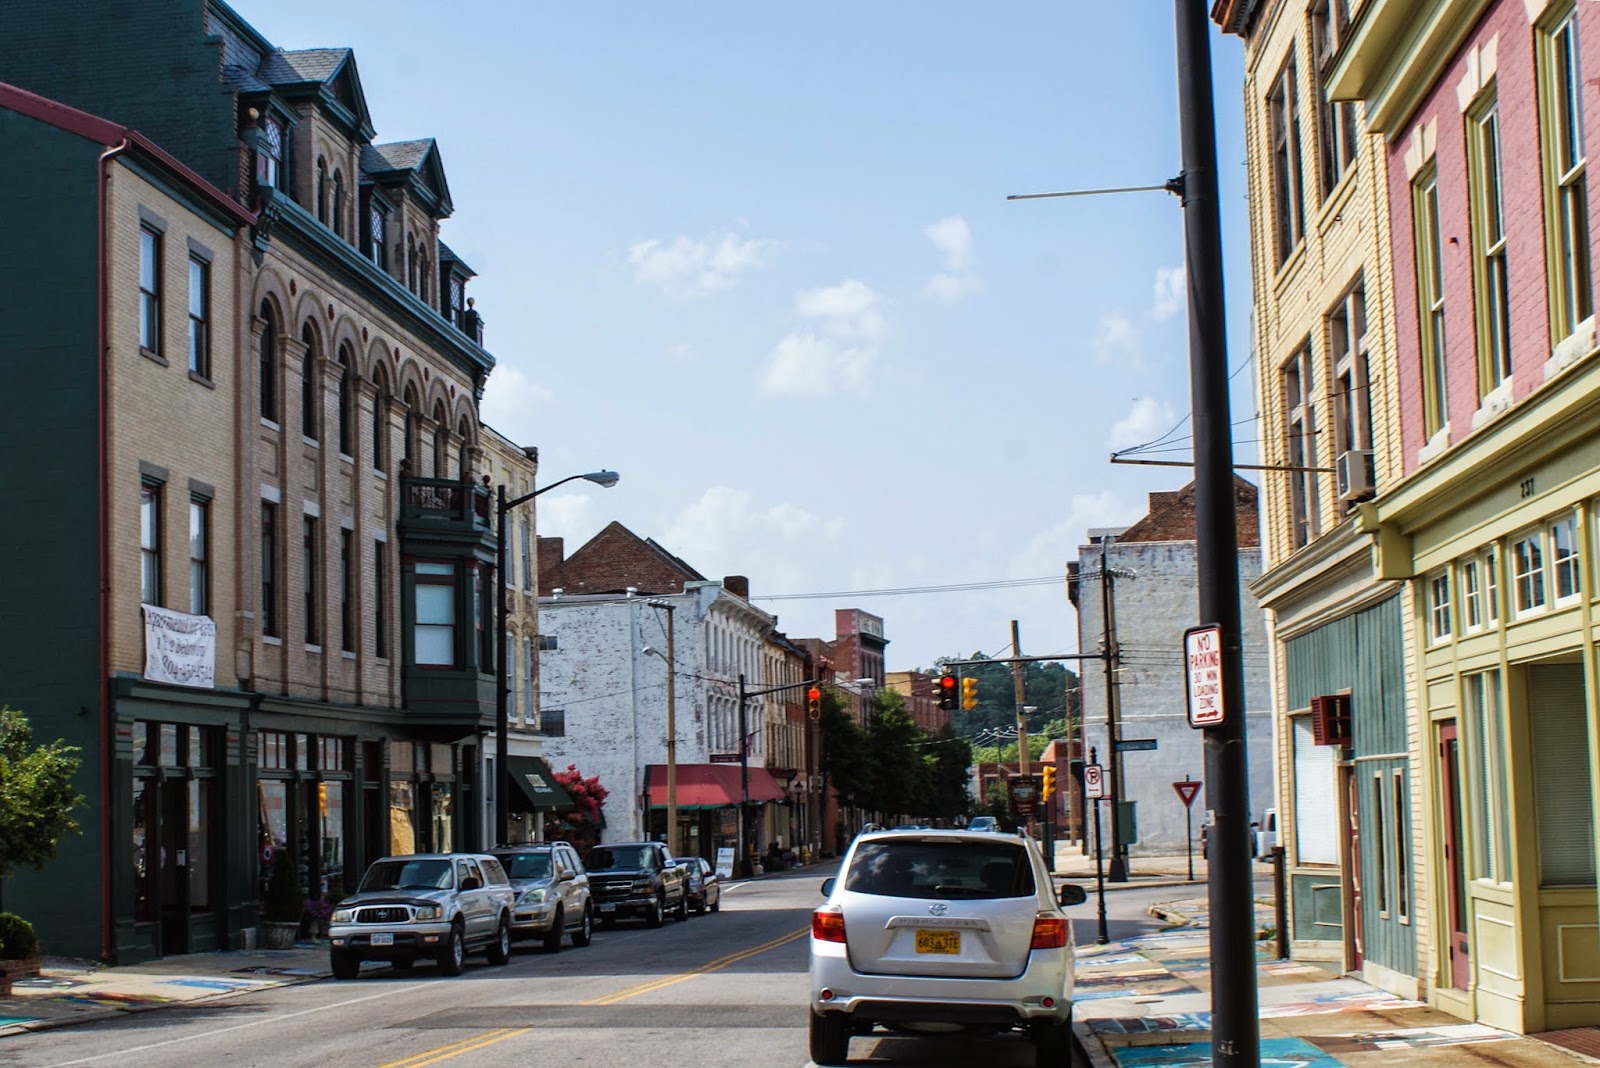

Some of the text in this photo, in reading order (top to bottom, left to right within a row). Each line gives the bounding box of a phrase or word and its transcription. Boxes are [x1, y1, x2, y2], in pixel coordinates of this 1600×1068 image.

[1520, 477, 1534, 499] 237
[1196, 634, 1211, 651] NO
[1189, 651, 1219, 670] PARKING
[1194, 669, 1218, 684] 30 MIN
[1194, 683, 1219, 698] LOADING
[1199, 697, 1215, 710] ZONE
